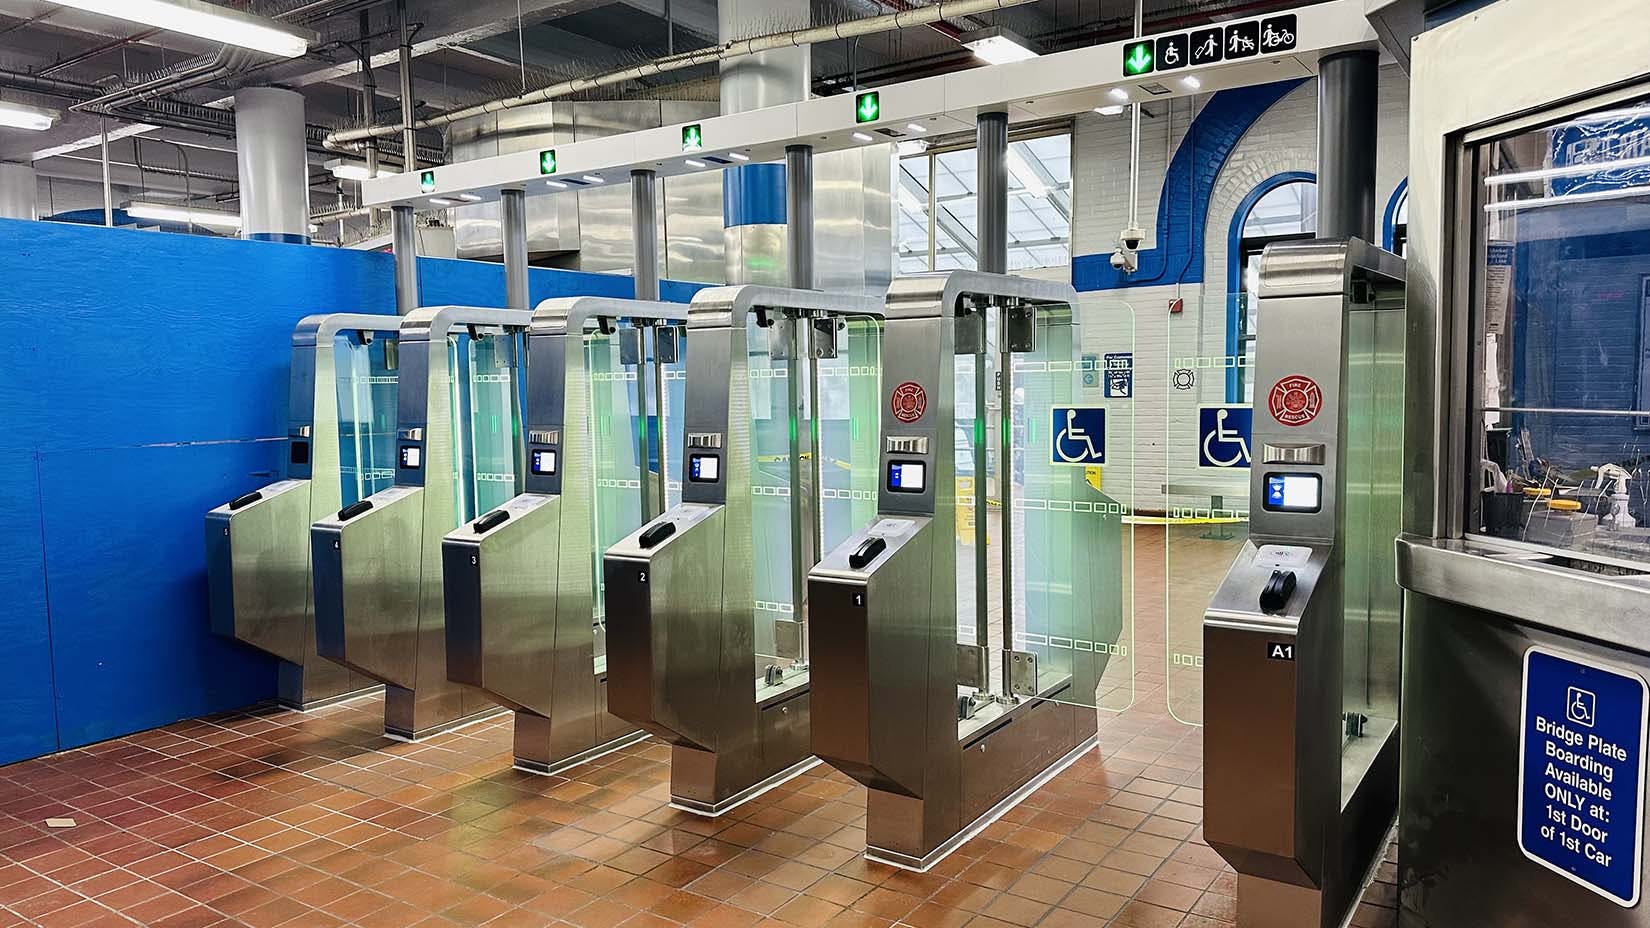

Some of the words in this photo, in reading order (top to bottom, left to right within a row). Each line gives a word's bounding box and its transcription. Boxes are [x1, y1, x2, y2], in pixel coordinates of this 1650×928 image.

[472, 556, 477, 565] 3
[640, 572, 646, 581] 2
[856, 595, 861, 605] 1
[1272, 645, 1292, 658] A1
[1536, 716, 1583, 746] Bridge
[1588, 734, 1627, 761] Plate
[1546, 741, 1613, 783] Boarding
[1545, 762, 1612, 801] Available
[1545, 783, 1585, 811] ONLY
[1590, 804, 1609, 822] at:
[1546, 805, 1567, 826] 1st
[1571, 814, 1608, 843] Door
[1541, 826, 1555, 840] of
[1560, 831, 1580, 853] 1st
[1584, 843, 1612, 867] Car
